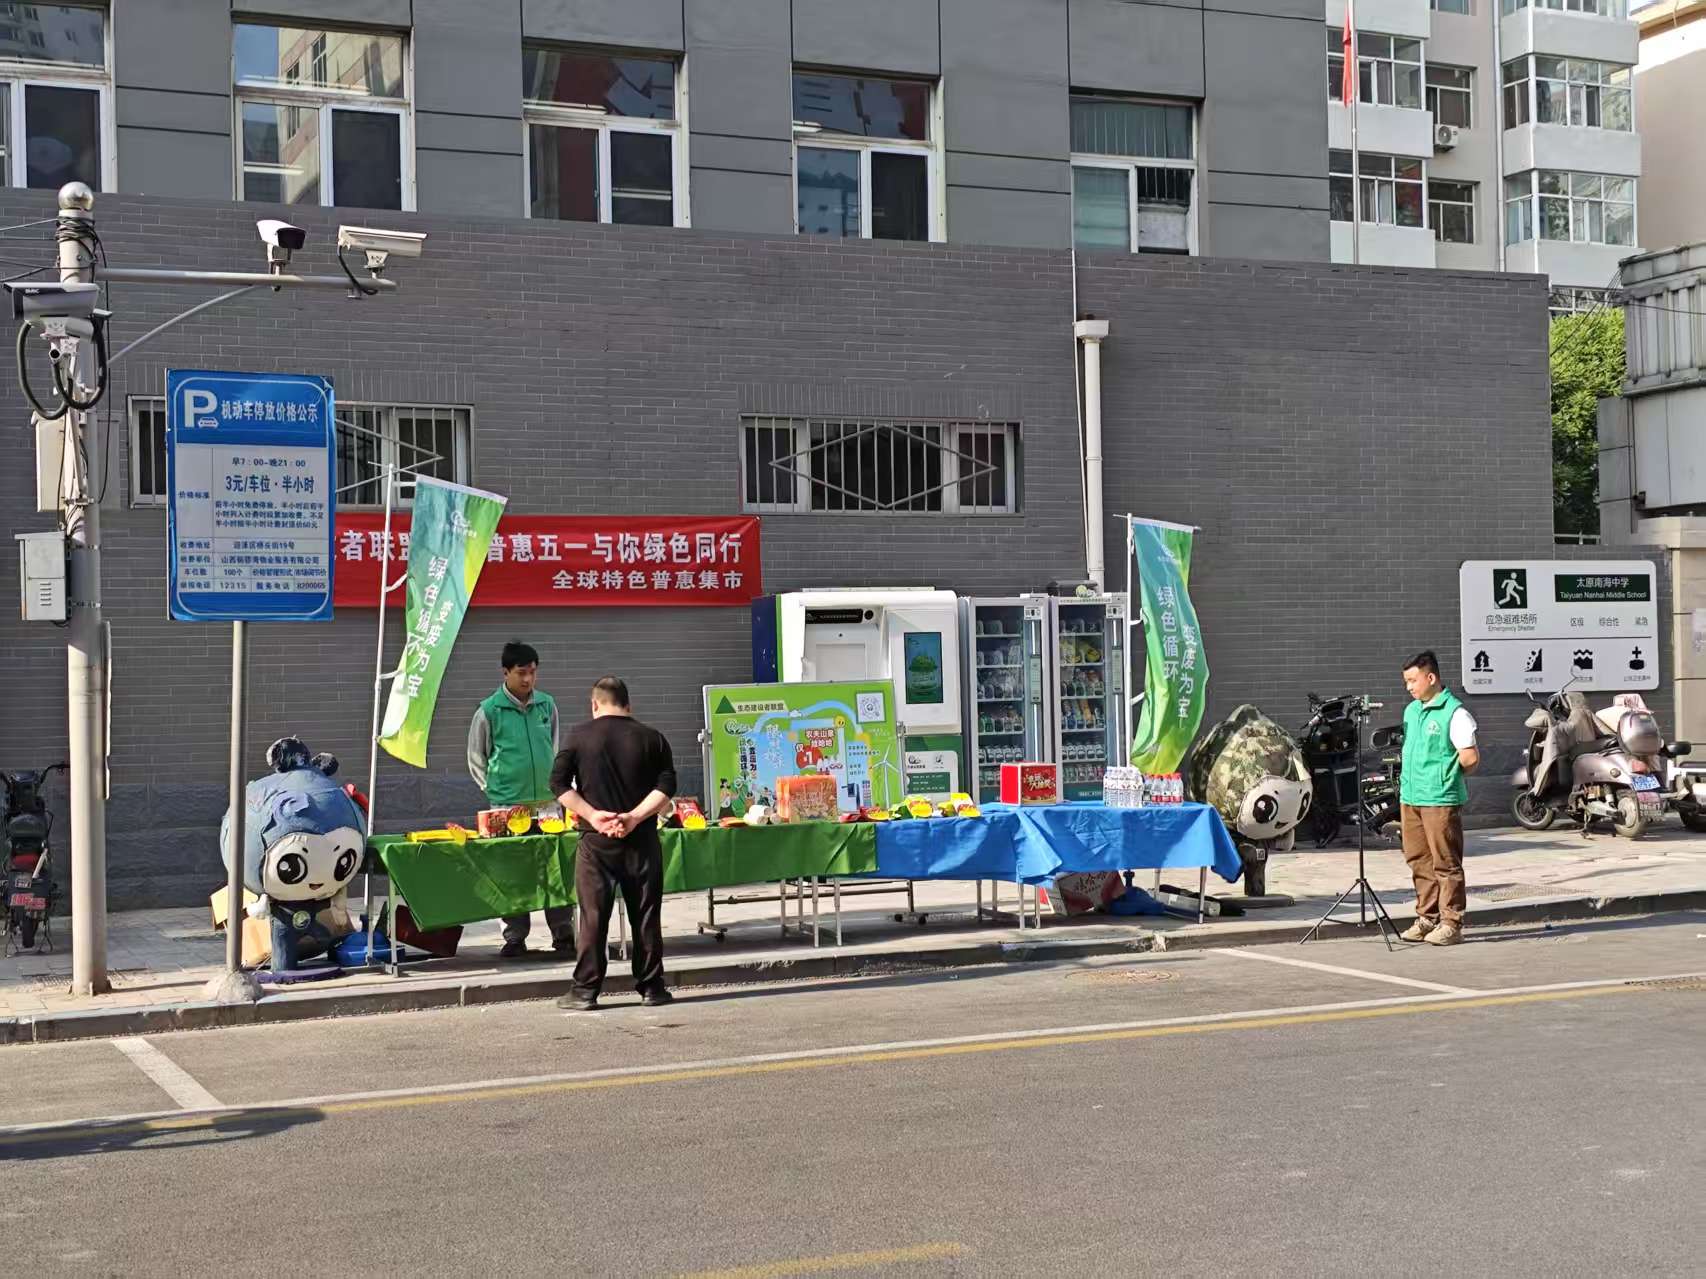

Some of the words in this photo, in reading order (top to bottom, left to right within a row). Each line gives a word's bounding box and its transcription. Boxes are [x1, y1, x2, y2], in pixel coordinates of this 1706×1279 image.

[184, 389, 218, 427] P
[221, 400, 318, 423] 机动车停放价格公示
[488, 532, 742, 564] 普惠五一与你绿色同行
[552, 569, 743, 591] 全球特色普惠集市
[1576, 577, 1629, 588] 太原南海中学
[1560, 591, 1583, 599] Taiyuan
[1486, 613, 1537, 625] 应急避难场所
[1157, 586, 1179, 683] 绿色循环
[1177, 623, 1198, 719] 变废为宝
[737, 702, 785, 712] 生态建设者联盟
